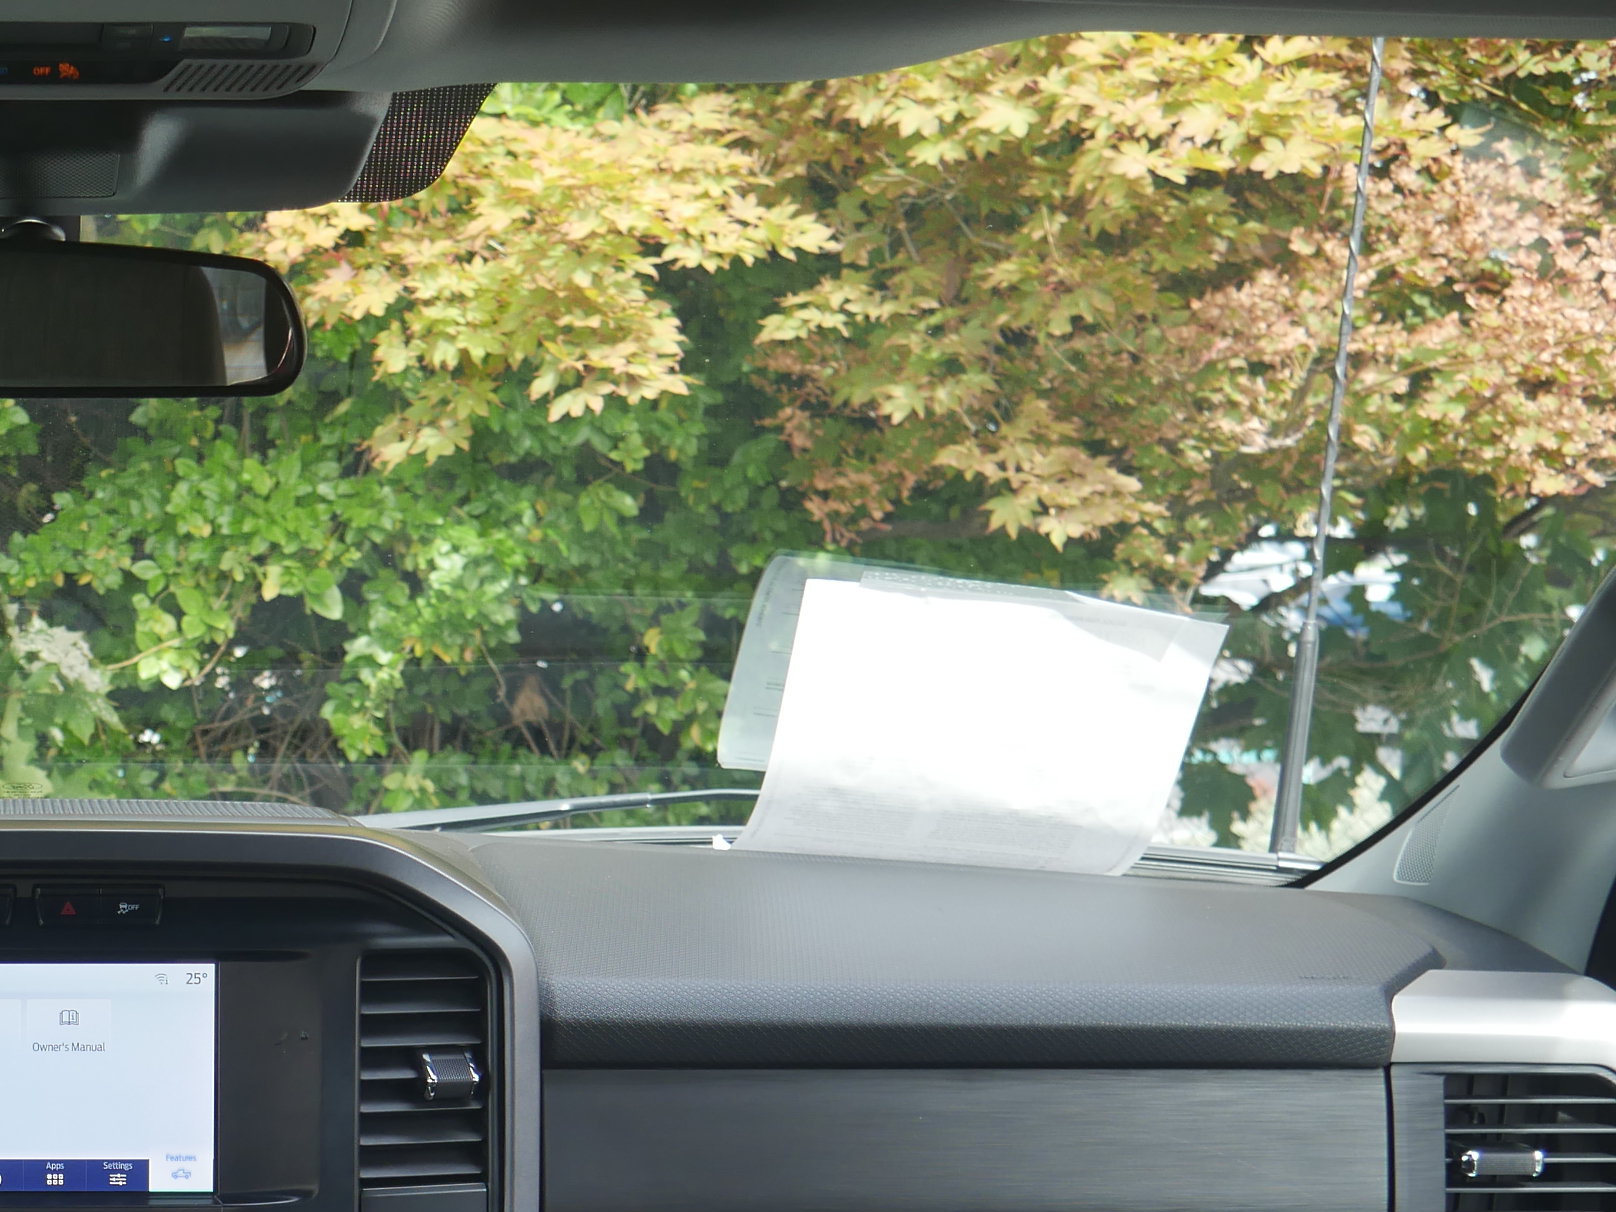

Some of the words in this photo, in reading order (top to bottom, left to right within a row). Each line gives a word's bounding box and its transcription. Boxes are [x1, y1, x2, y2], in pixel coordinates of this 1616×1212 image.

[32, 1041, 70, 1052] Owner's
[71, 1041, 106, 1052] Manual
[165, 1153, 197, 1162] Features
[45, 1161, 65, 1171] Apps
[102, 1161, 133, 1171] Settings
